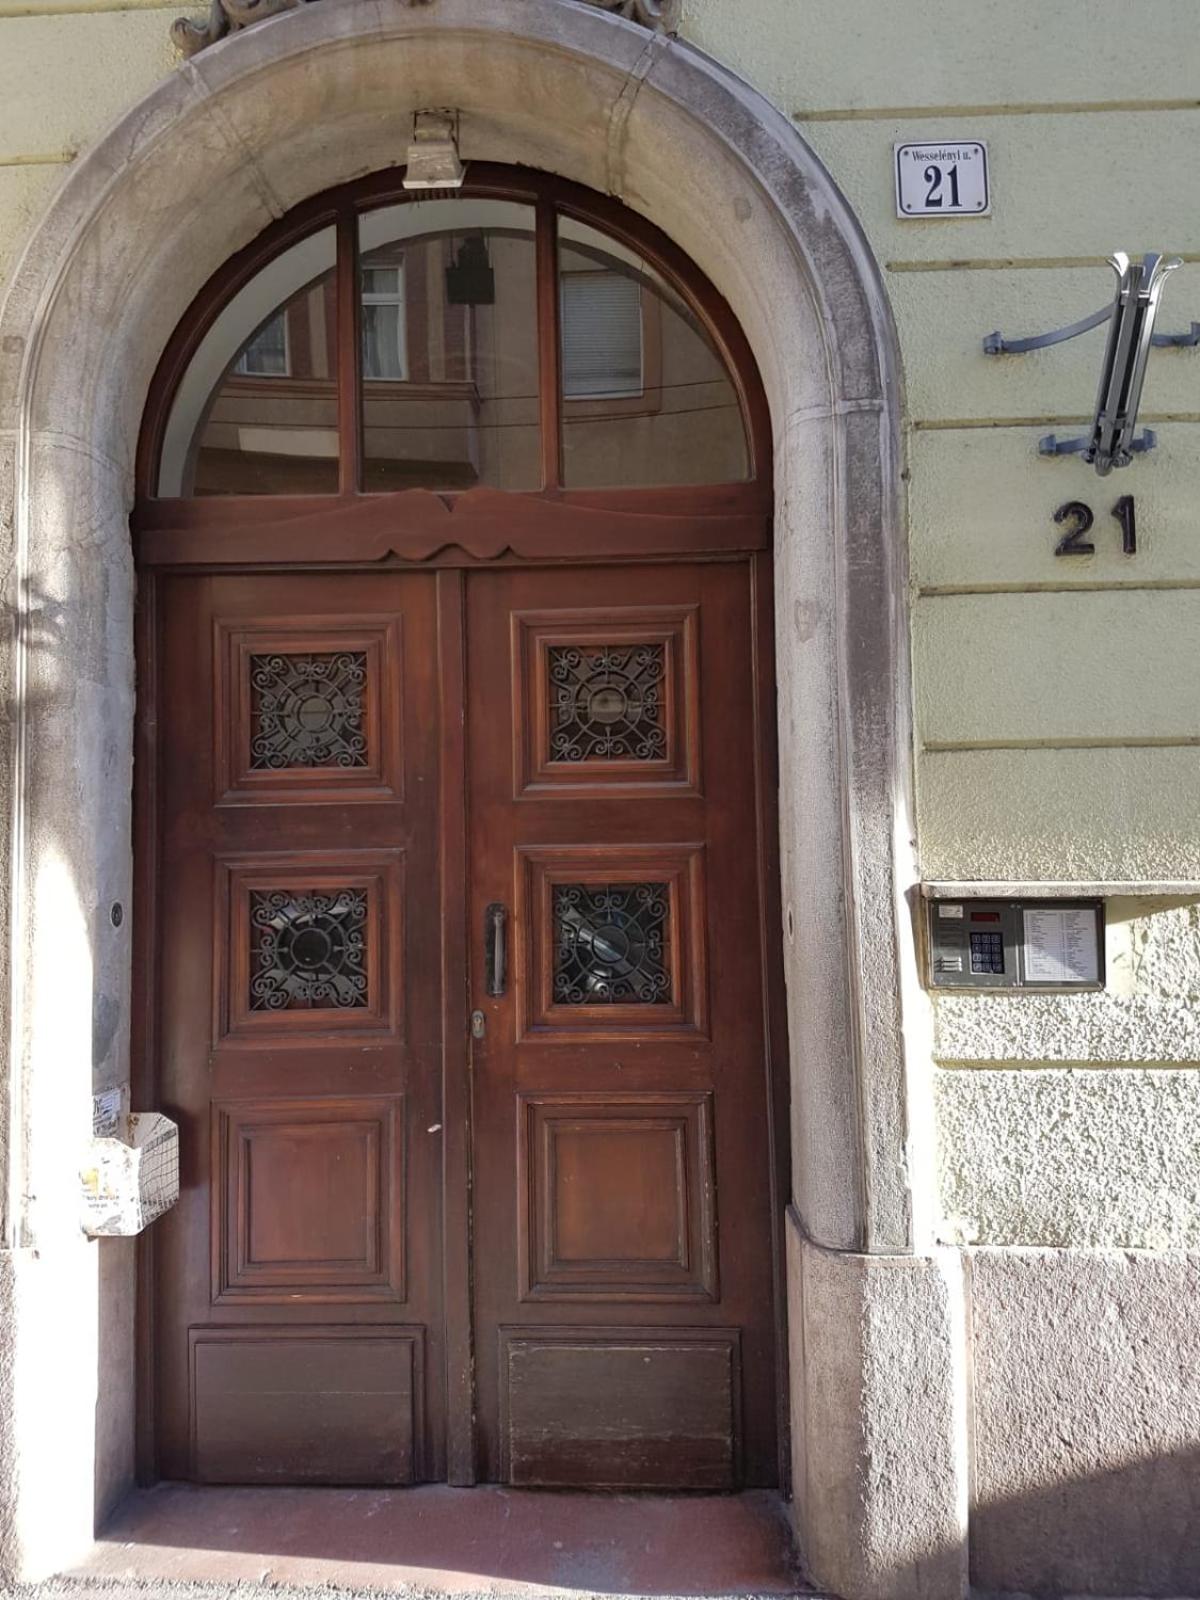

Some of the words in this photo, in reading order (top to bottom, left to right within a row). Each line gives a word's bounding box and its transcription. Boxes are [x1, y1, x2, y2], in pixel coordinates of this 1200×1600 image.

[912, 149, 960, 163] Wesselényi
[963, 151, 972, 160] u.
[924, 164, 962, 208] 21
[1054, 494, 1137, 556] 21
